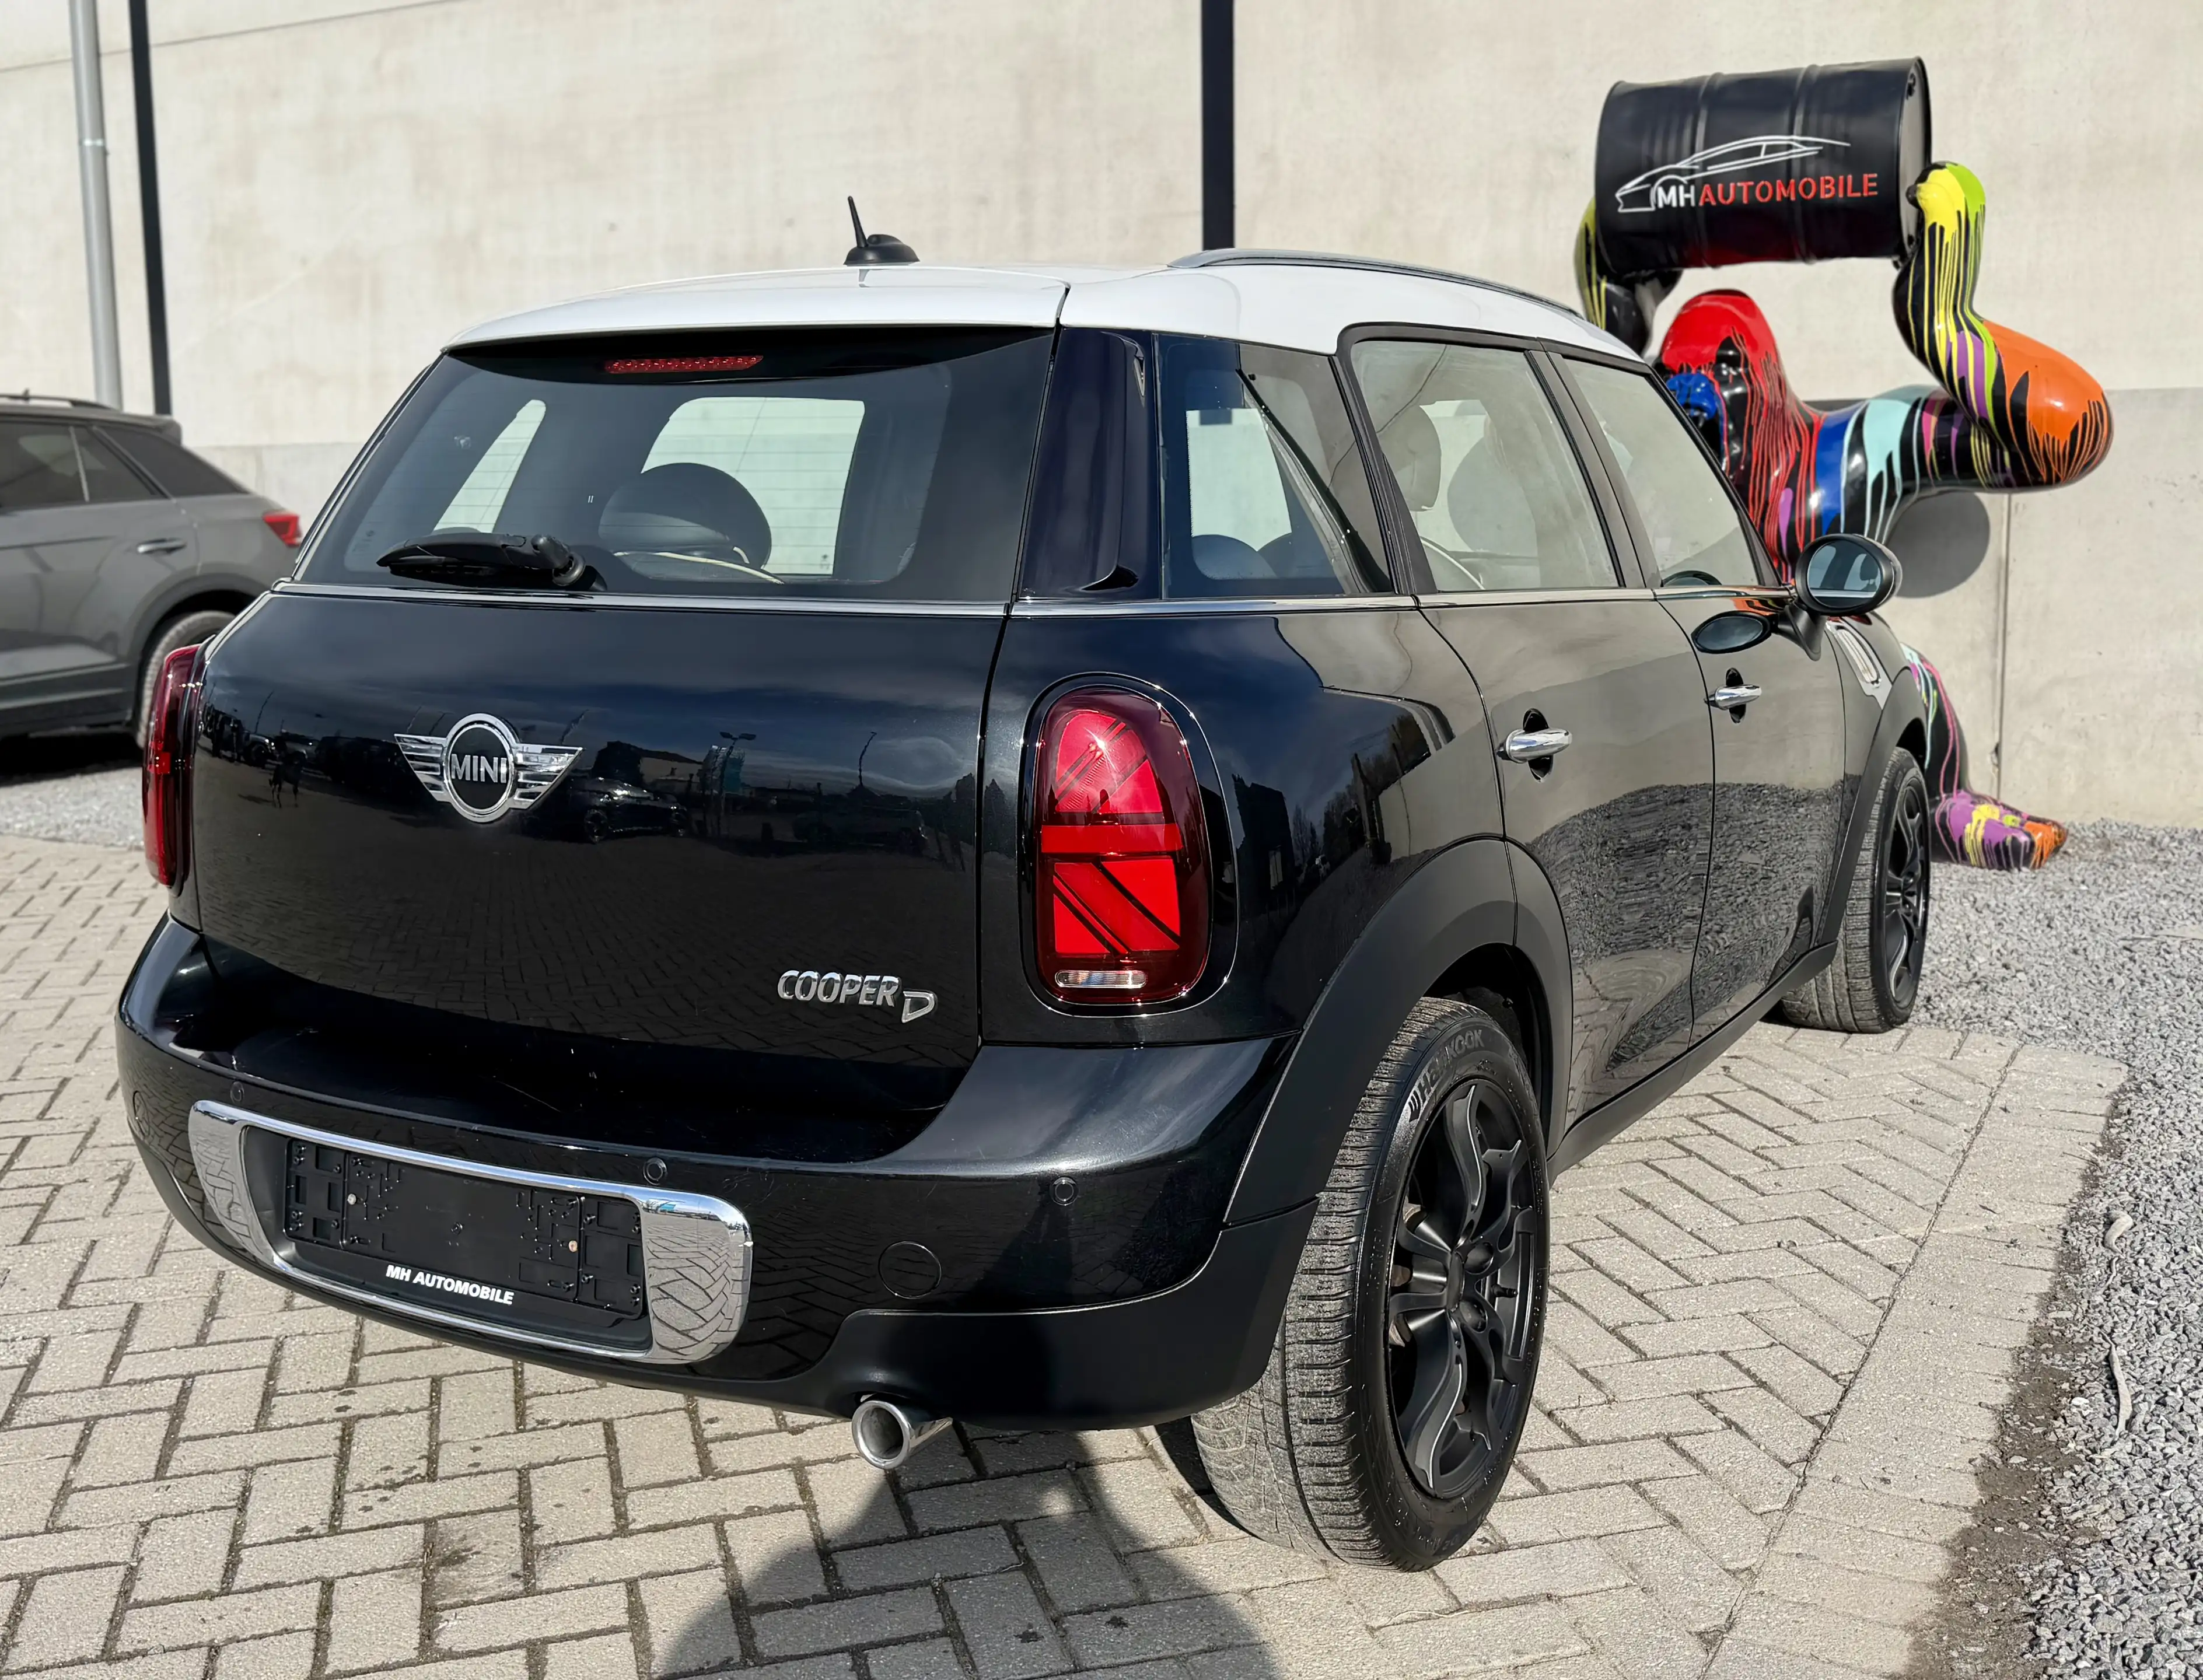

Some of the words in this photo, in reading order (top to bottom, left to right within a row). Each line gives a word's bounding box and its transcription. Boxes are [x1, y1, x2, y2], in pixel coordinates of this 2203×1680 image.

[451, 753, 507, 784] MINI
[777, 970, 901, 1007] COOPER
[901, 990, 938, 1024] D
[386, 1264, 411, 1282] MH
[412, 1271, 515, 1305] AUTOMOBILE
